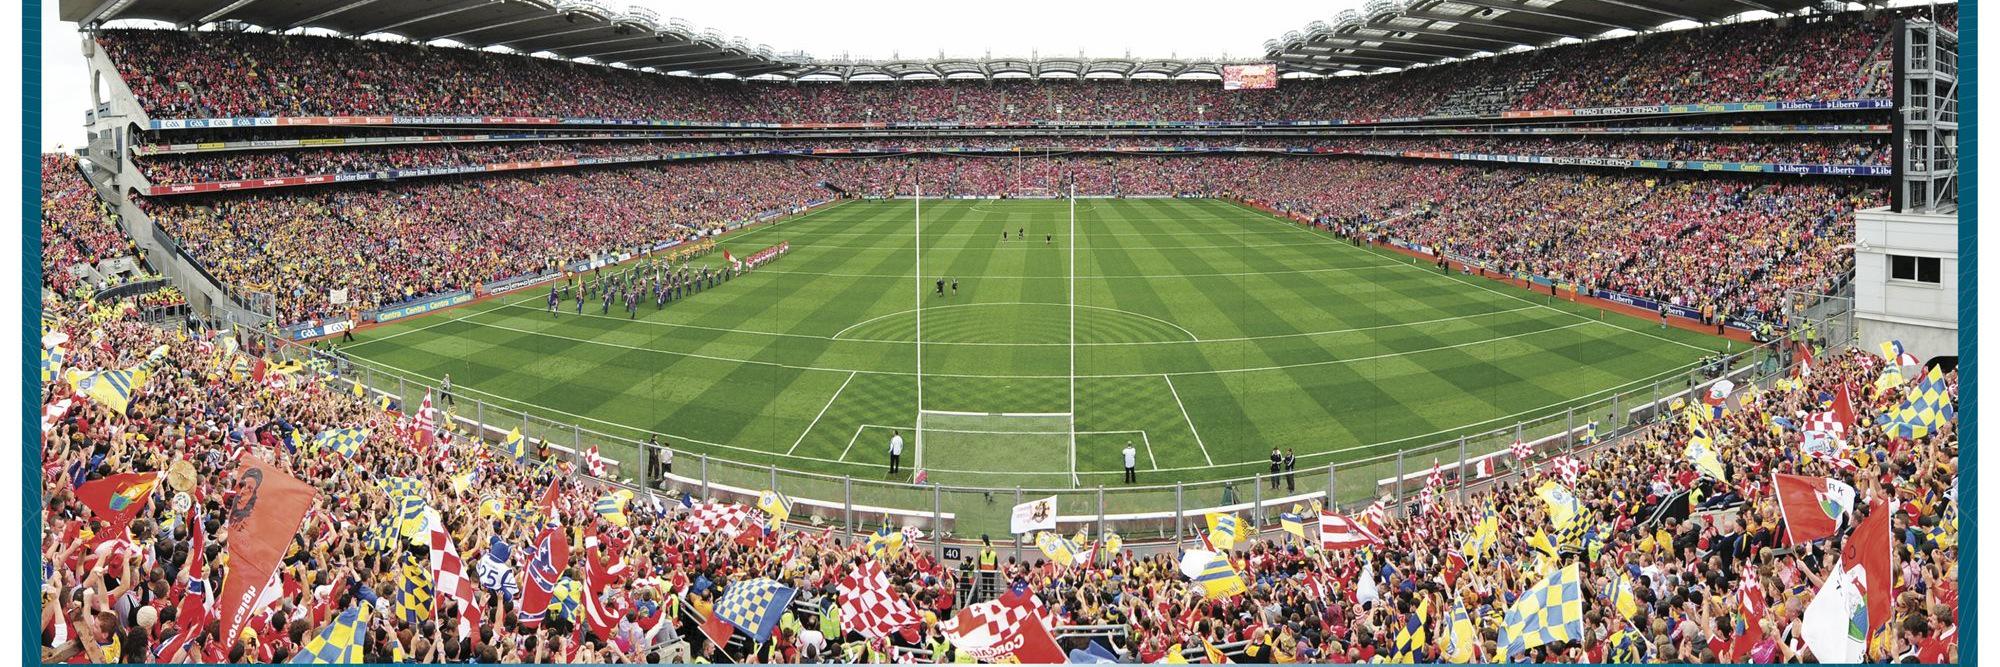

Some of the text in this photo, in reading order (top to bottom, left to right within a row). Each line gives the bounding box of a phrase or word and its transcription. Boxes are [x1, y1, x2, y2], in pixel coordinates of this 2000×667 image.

[1786, 101, 1812, 109] Liberty
[1831, 101, 1860, 109] Liberty
[1783, 164, 1810, 173] Liberty
[1827, 165, 1855, 174] Liberty
[946, 549, 958, 559] 40
[480, 565, 497, 587] 25
